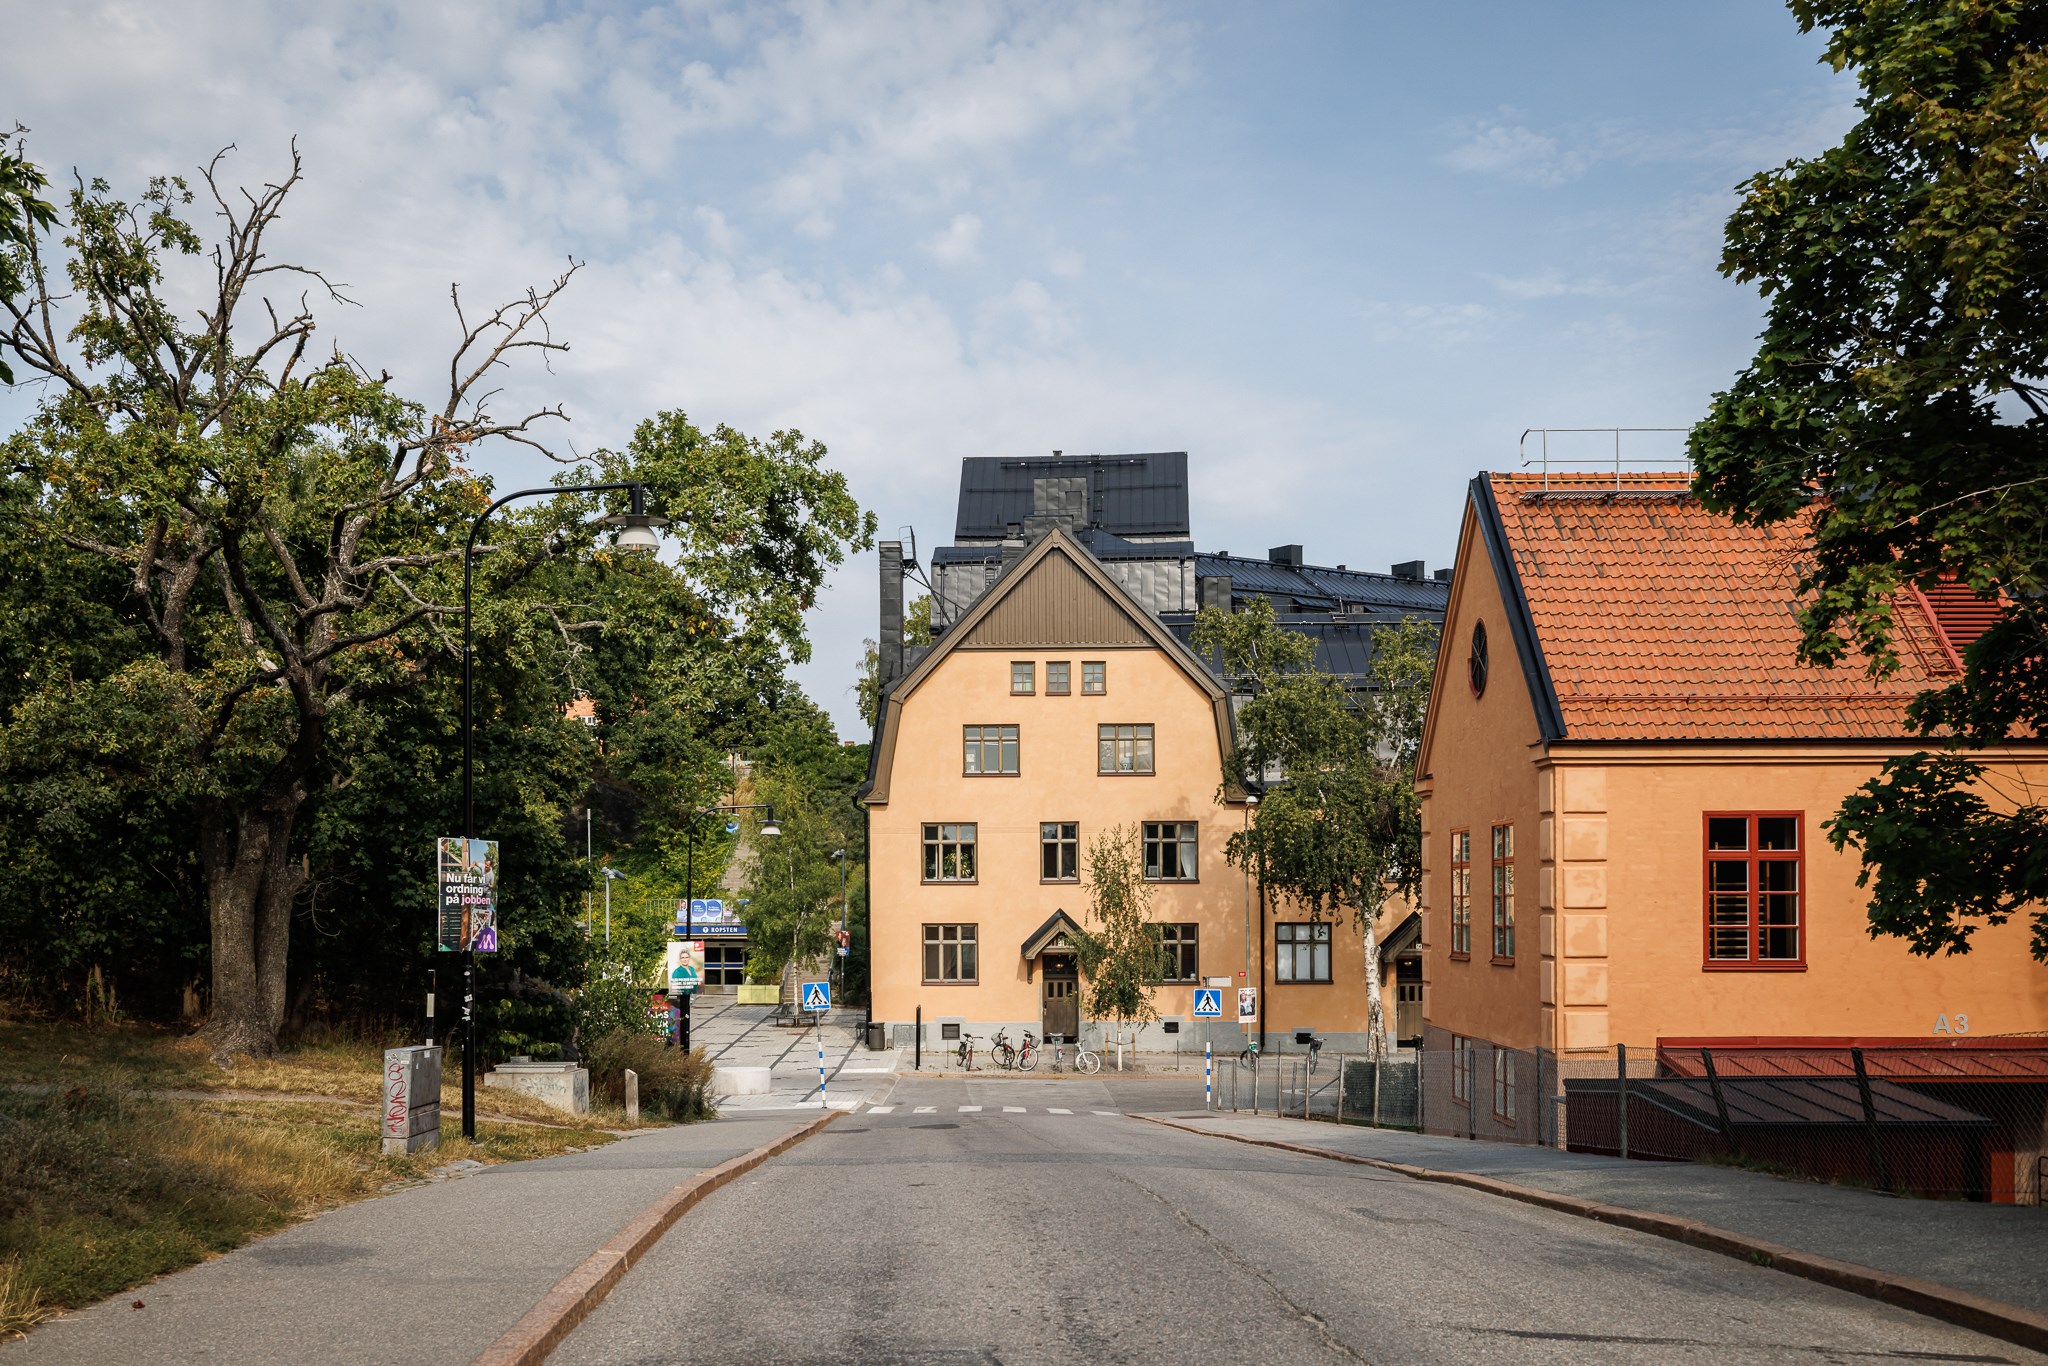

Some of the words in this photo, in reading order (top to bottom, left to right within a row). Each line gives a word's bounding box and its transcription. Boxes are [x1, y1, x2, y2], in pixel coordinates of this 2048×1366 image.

[446, 873, 461, 883] Nu
[463, 873, 477, 883] får
[478, 875, 485, 883] vi
[446, 884, 483, 896] ordning
[446, 893, 459, 905] på
[461, 895, 491, 905] jobben
[1933, 1013, 1969, 1034] A3
